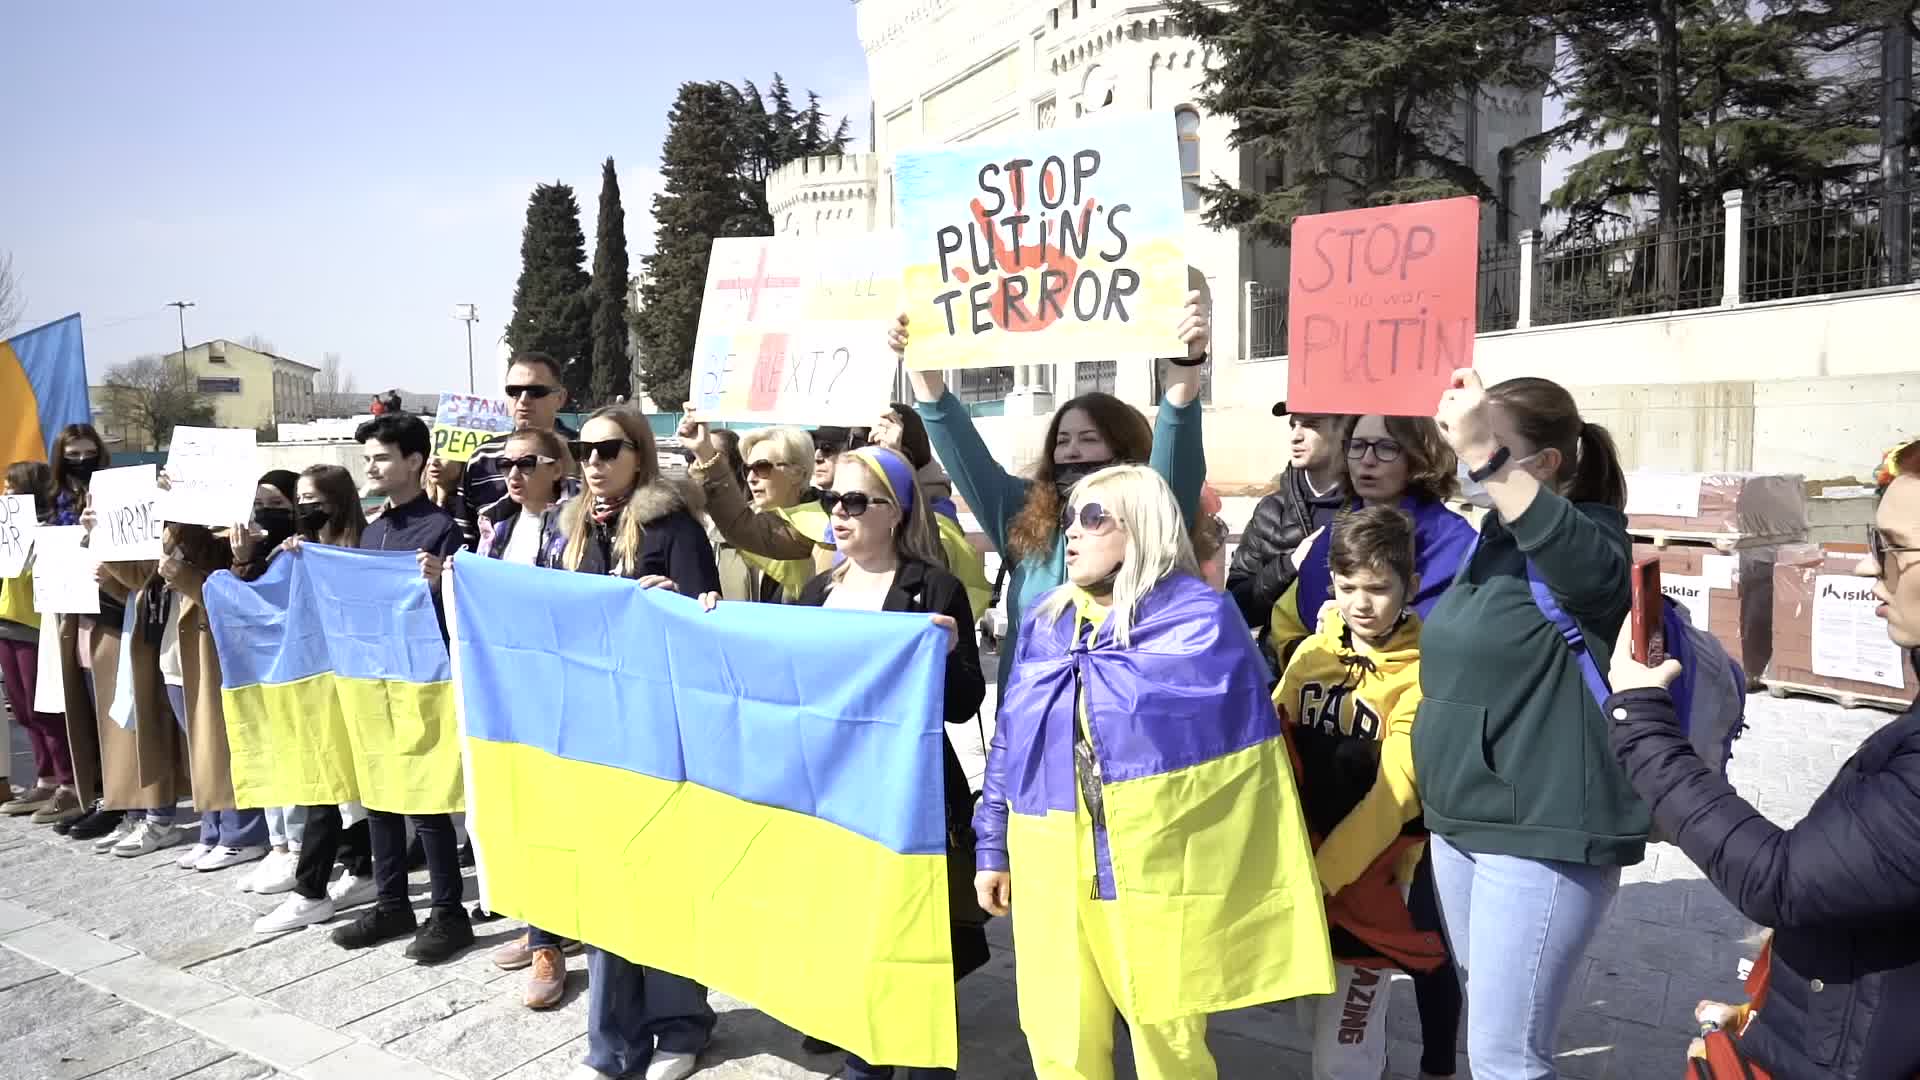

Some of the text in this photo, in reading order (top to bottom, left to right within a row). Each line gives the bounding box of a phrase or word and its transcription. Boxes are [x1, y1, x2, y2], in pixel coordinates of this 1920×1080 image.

[978, 149, 1101, 216] STOP
[1297, 222, 1435, 293] STOP
[933, 268, 1140, 336] TERROR
[448, 394, 508, 417] STAN
[433, 429, 495, 457] PEA
[1299, 681, 1381, 741] GAP
[1338, 967, 1381, 1045] AZING
